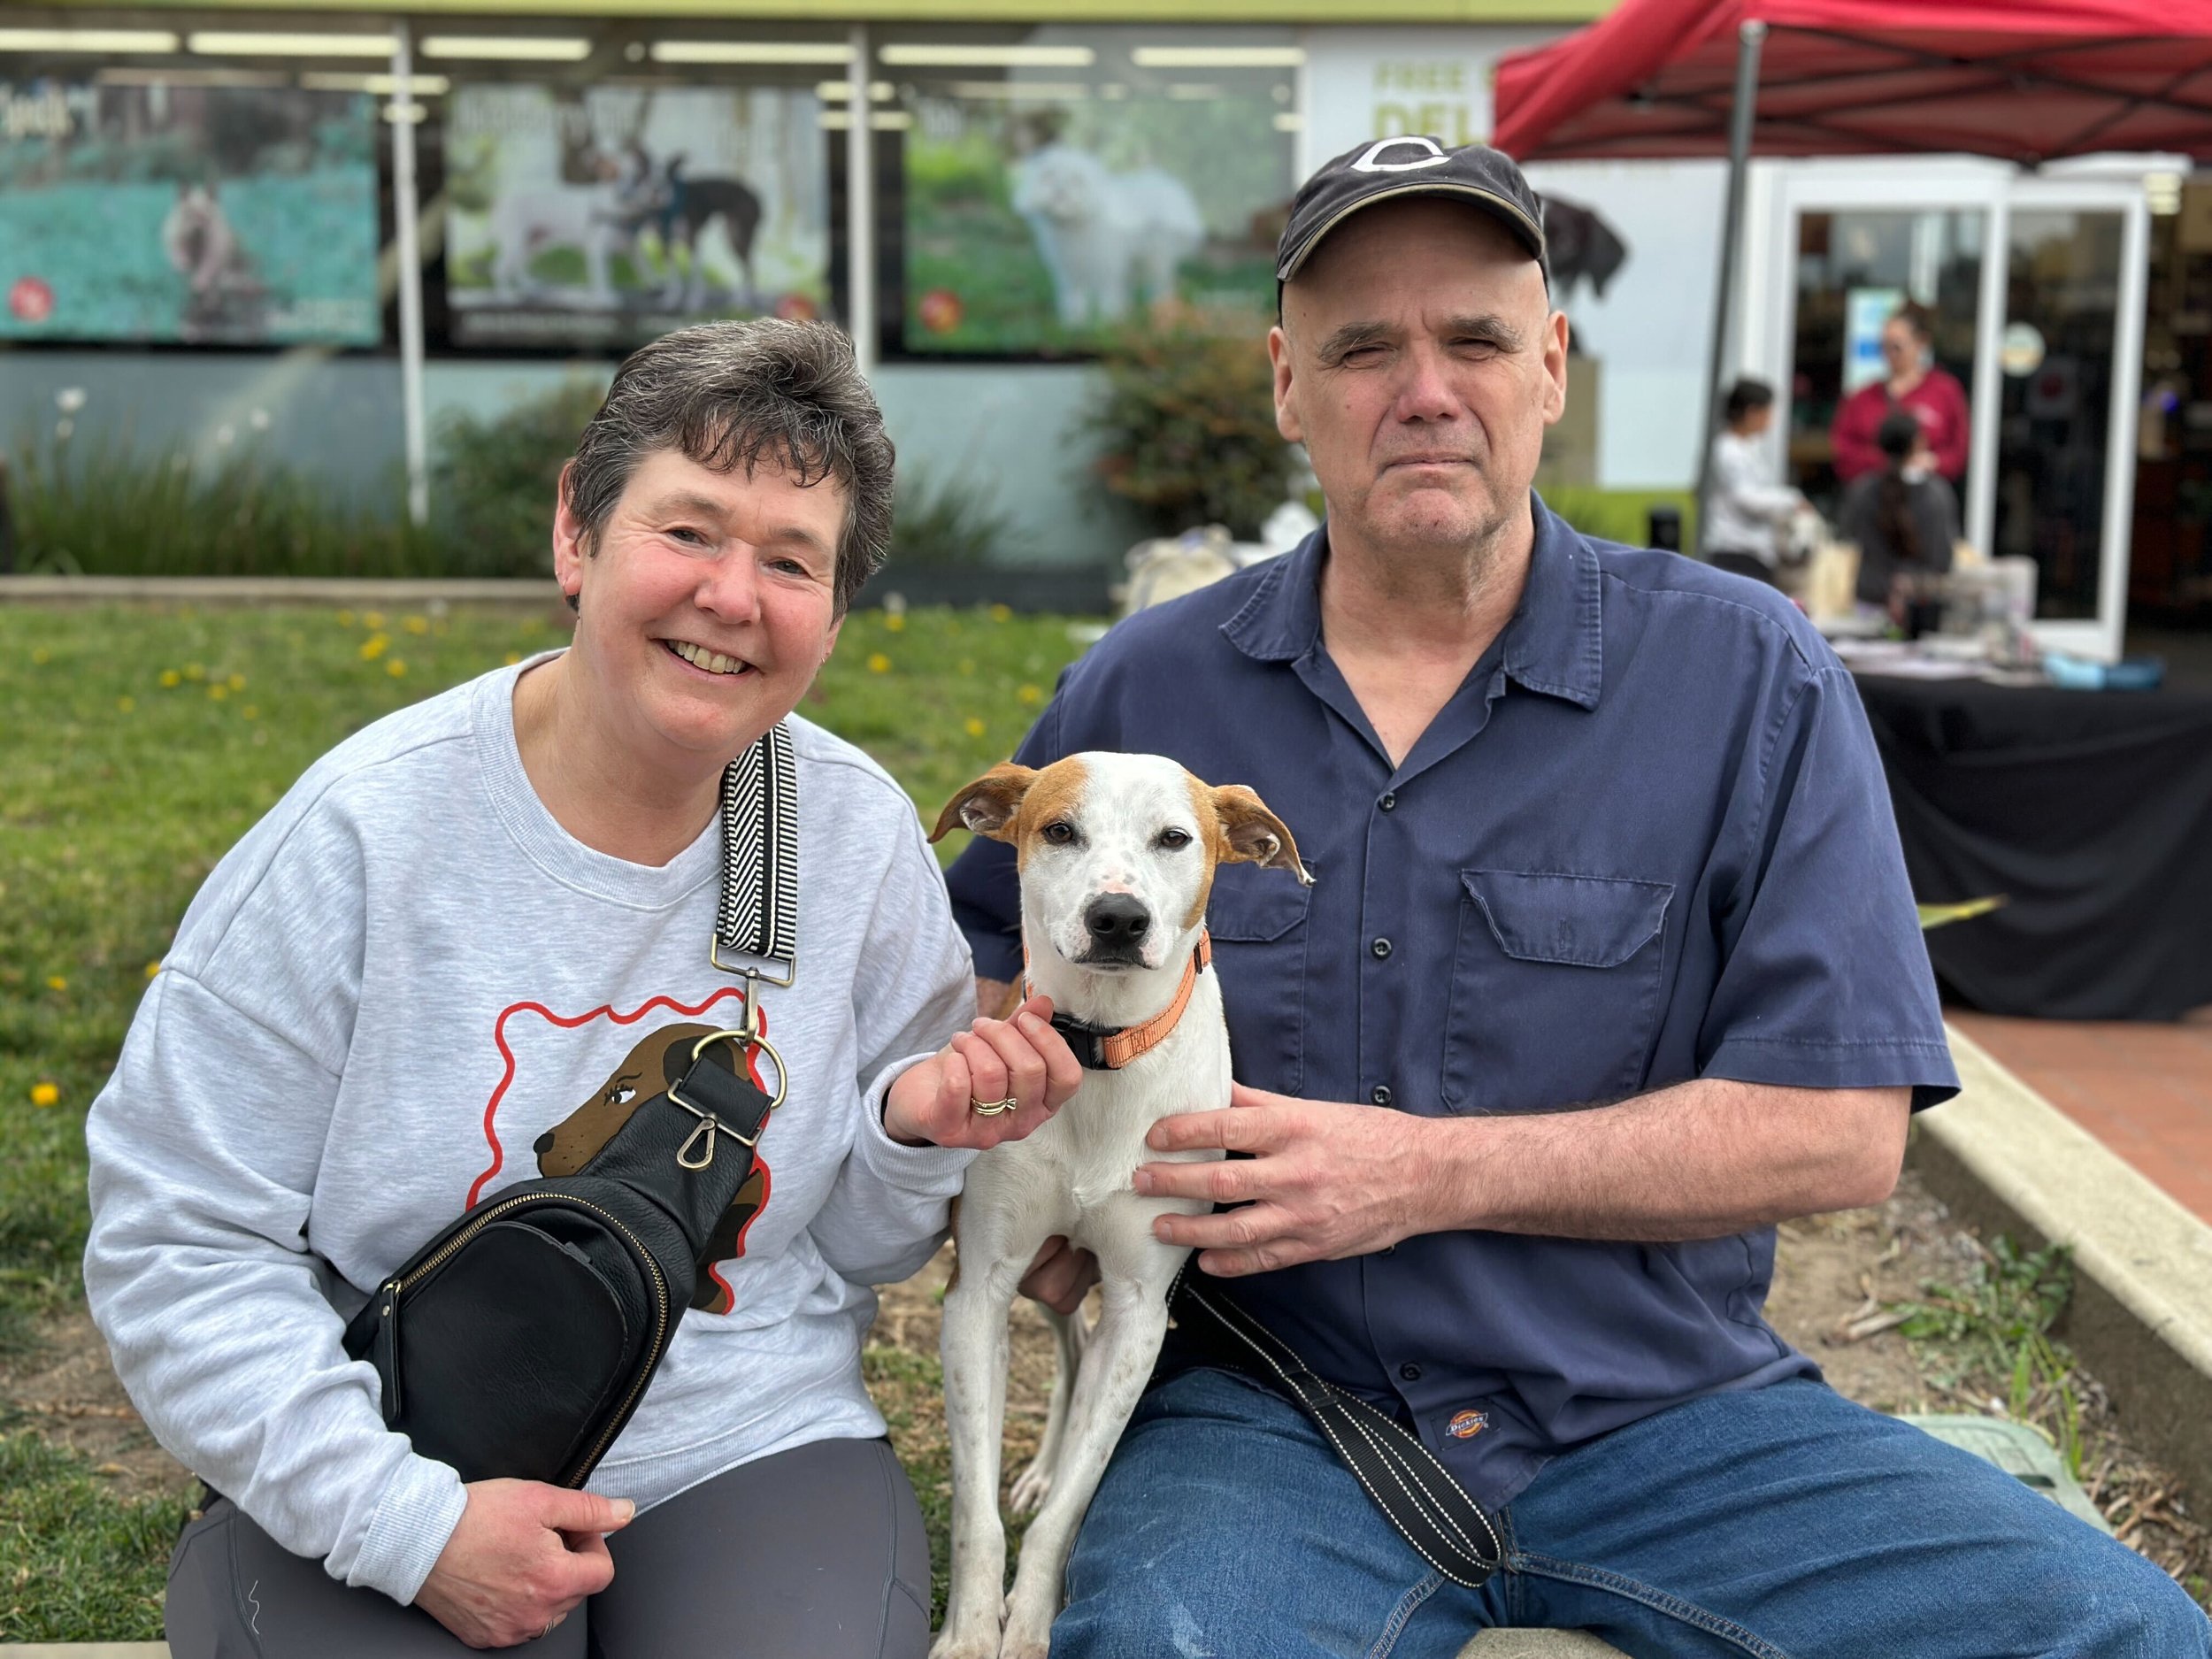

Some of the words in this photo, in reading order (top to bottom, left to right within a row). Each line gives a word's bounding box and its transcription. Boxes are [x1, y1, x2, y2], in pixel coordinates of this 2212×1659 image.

[1375, 62, 1463, 92] FREE
[1350, 135, 1452, 173] C
[1450, 1416, 1484, 1432] Dickies
